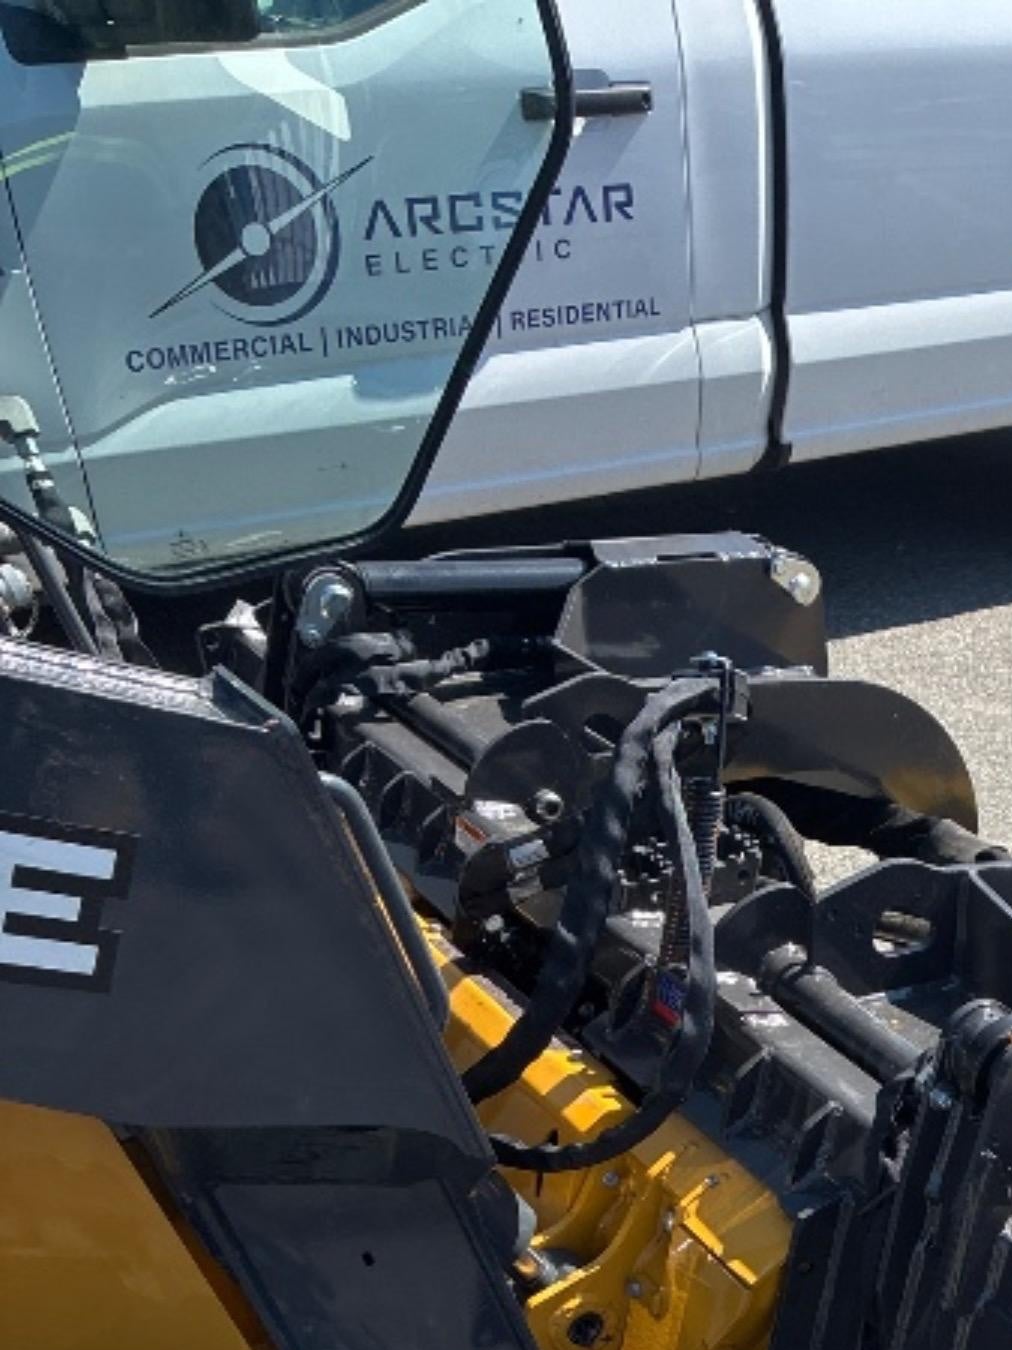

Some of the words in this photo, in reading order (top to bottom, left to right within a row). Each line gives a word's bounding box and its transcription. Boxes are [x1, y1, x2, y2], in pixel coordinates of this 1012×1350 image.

[365, 239, 572, 277] ELECTIC
[126, 332, 314, 373] COMMERCIAL
[336, 314, 476, 349] INDUSTRIA
[509, 297, 661, 331] RESIDENTIAL
